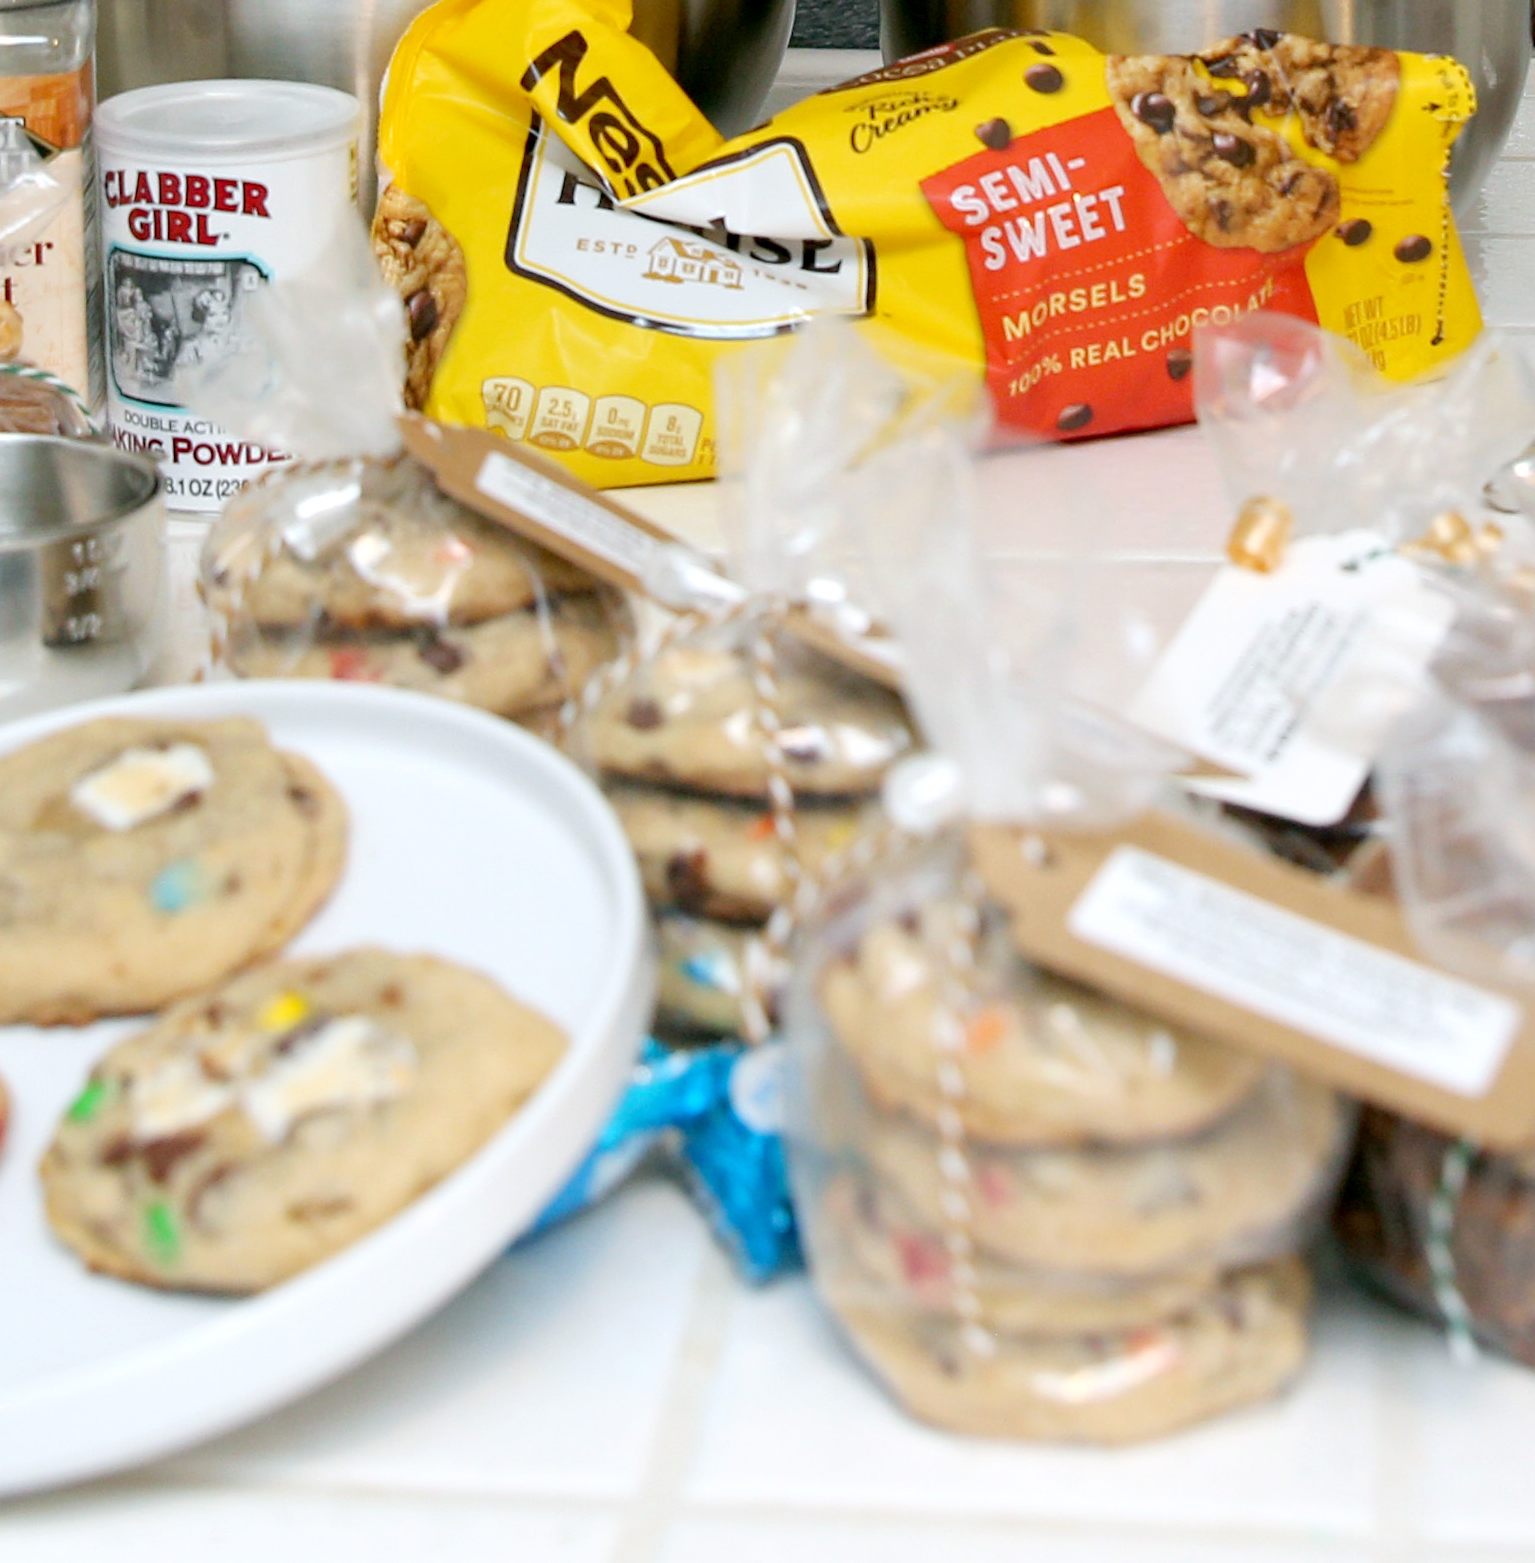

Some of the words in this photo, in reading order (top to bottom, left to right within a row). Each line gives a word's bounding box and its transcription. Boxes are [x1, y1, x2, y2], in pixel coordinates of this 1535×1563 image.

[851, 98, 959, 154] Creamy
[105, 170, 272, 219] CLABBER
[950, 152, 1085, 226] SEMI-
[128, 208, 221, 246] GIRL
[980, 186, 1126, 271] SWEET
[1002, 274, 1147, 342] MORSELS
[1008, 354, 1063, 397] 100%
[1070, 338, 1136, 369] REAL
[124, 409, 178, 434] DOUBLE
[172, 437, 293, 467] POWDE
[187, 479, 214, 497] OZ
